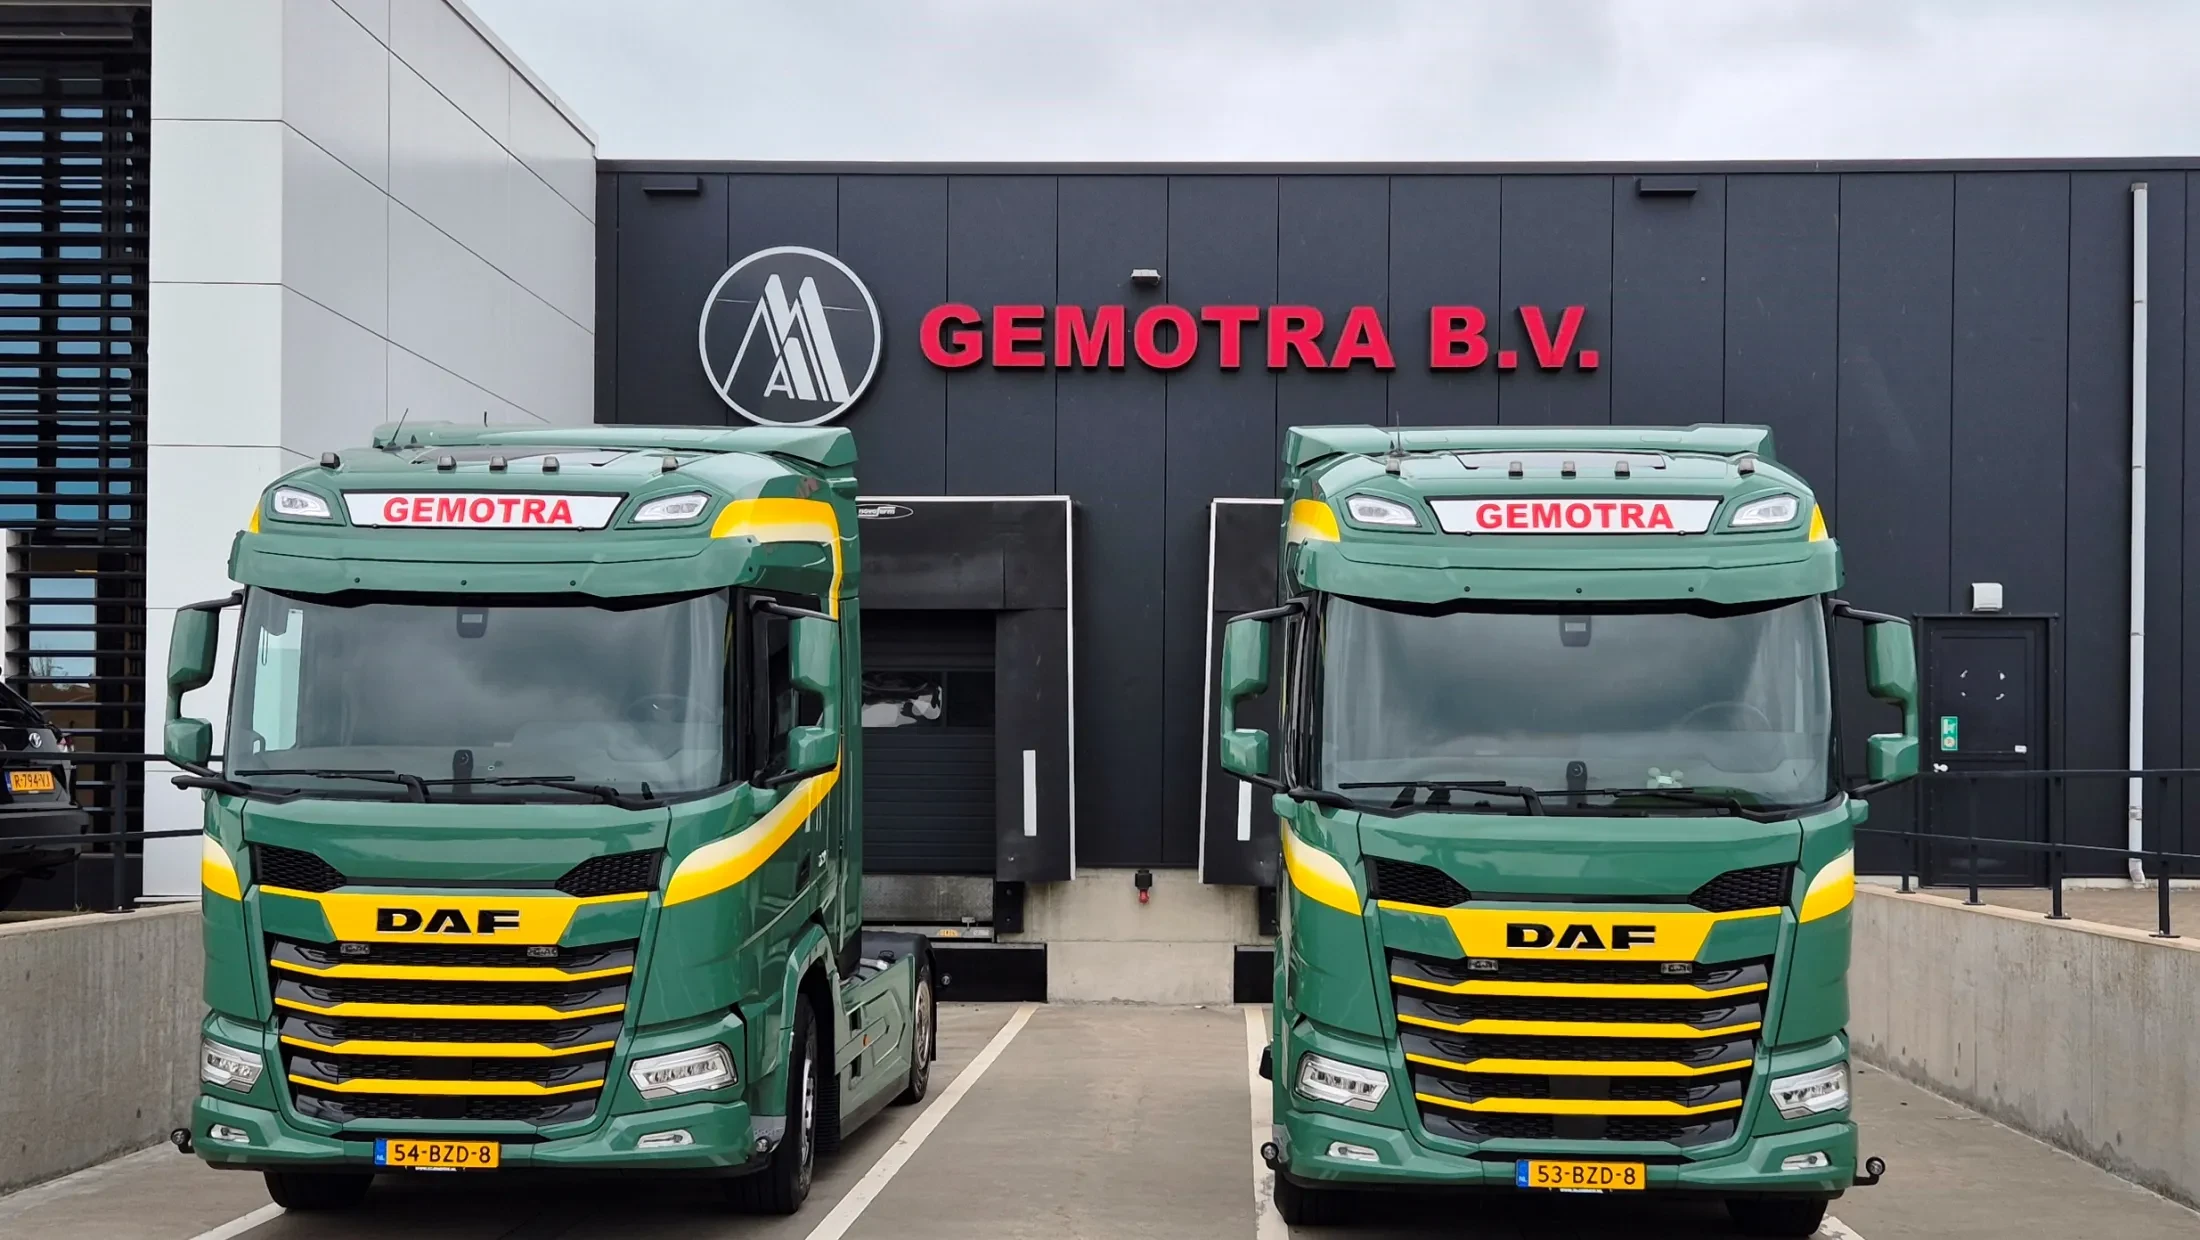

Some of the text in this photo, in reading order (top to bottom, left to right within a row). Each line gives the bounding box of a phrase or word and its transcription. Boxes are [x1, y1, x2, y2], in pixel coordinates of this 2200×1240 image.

[919, 303, 1599, 370] GEMOTRA B.V.
[383, 497, 573, 524] GEMOTRA
[1476, 503, 1674, 529] GEMOTRA
[13, 773, 51, 788] R-794-VJ
[376, 908, 520, 935] DAF
[1506, 923, 1656, 951] DAF
[394, 1144, 491, 1163] 54-BZD-8
[1537, 1165, 1636, 1185] 53-BZD-8
